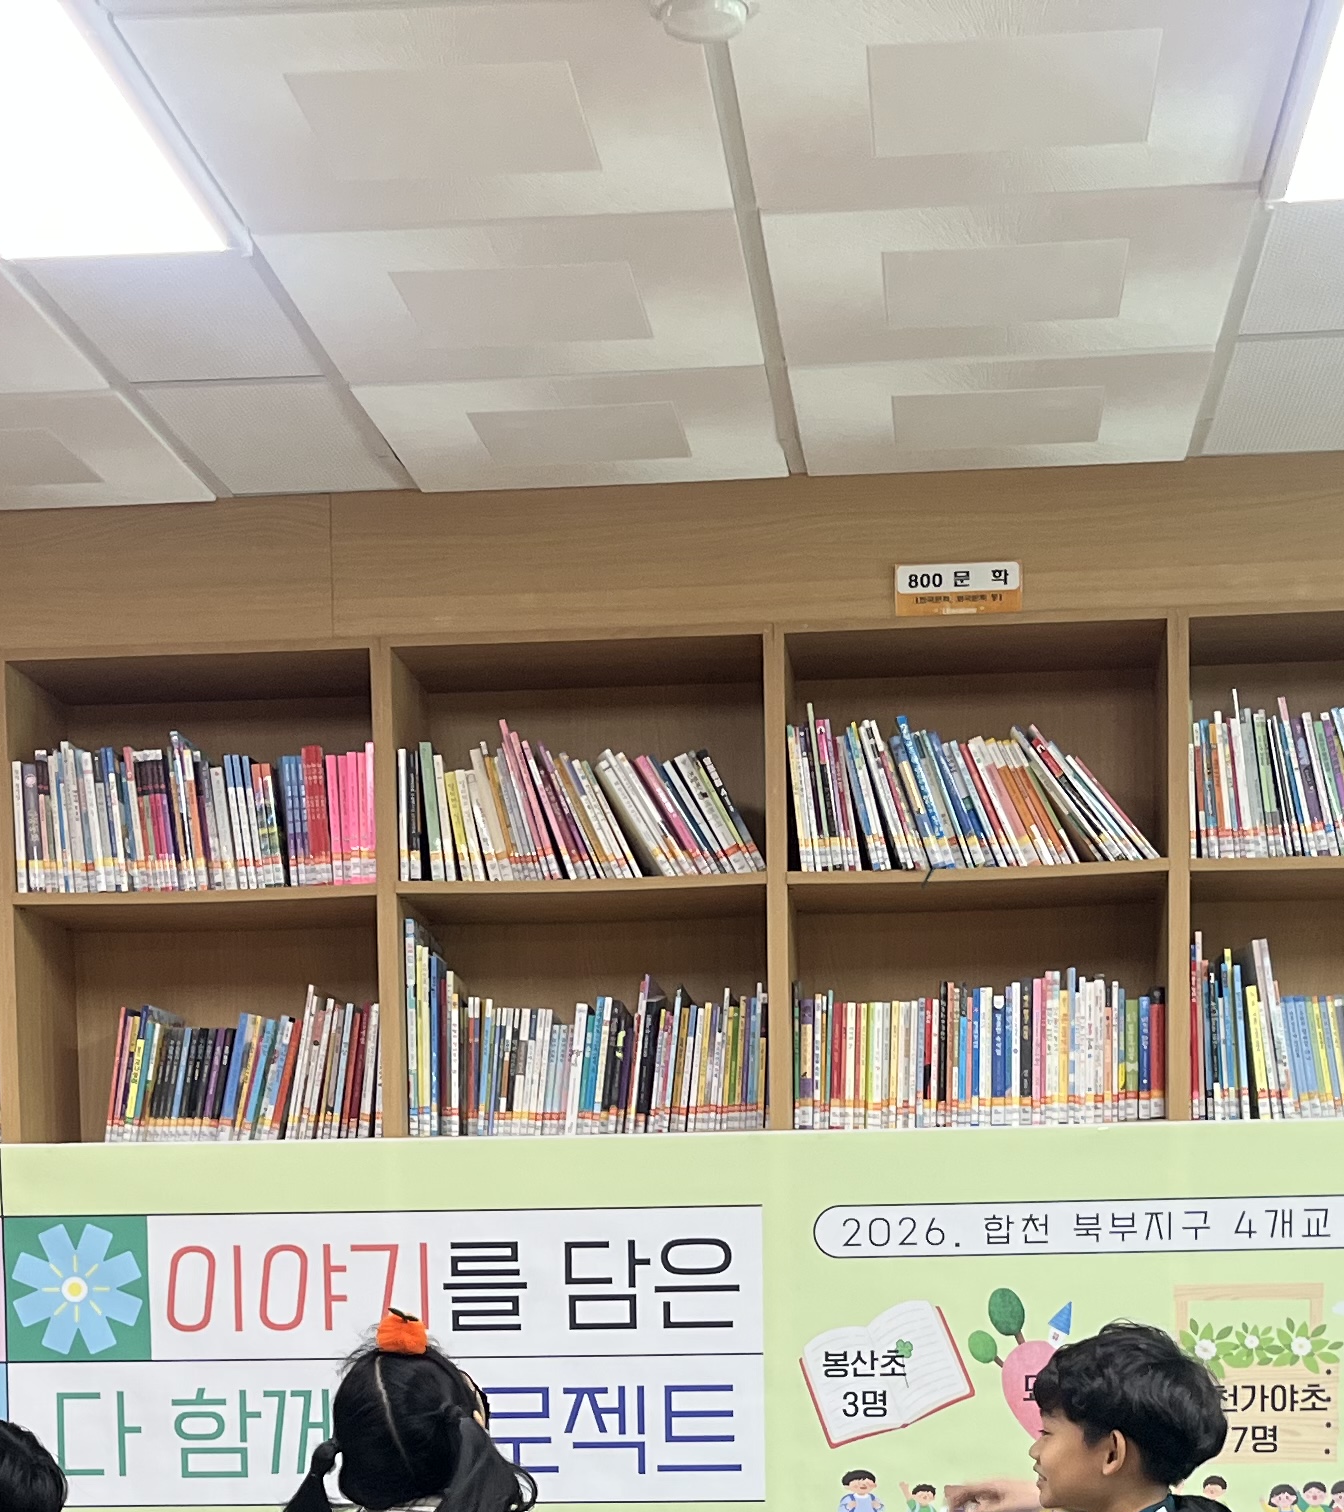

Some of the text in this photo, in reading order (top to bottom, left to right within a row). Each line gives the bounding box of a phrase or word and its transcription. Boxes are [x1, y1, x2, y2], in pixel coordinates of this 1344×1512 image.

[908, 568, 1009, 589] 800 문 학
[842, 1216, 961, 1248] 2026.
[983, 1213, 1049, 1245] 합천
[1072, 1210, 1211, 1243] 북부지구
[1234, 1207, 1331, 1240] 4개교
[166, 1237, 741, 1336] 이야기를 담은
[822, 1347, 907, 1378] 봉산초
[842, 1389, 888, 1418] 3명
[1218, 1382, 1329, 1415] 천가야초
[57, 1384, 743, 1478] 다 함께 로젝트
